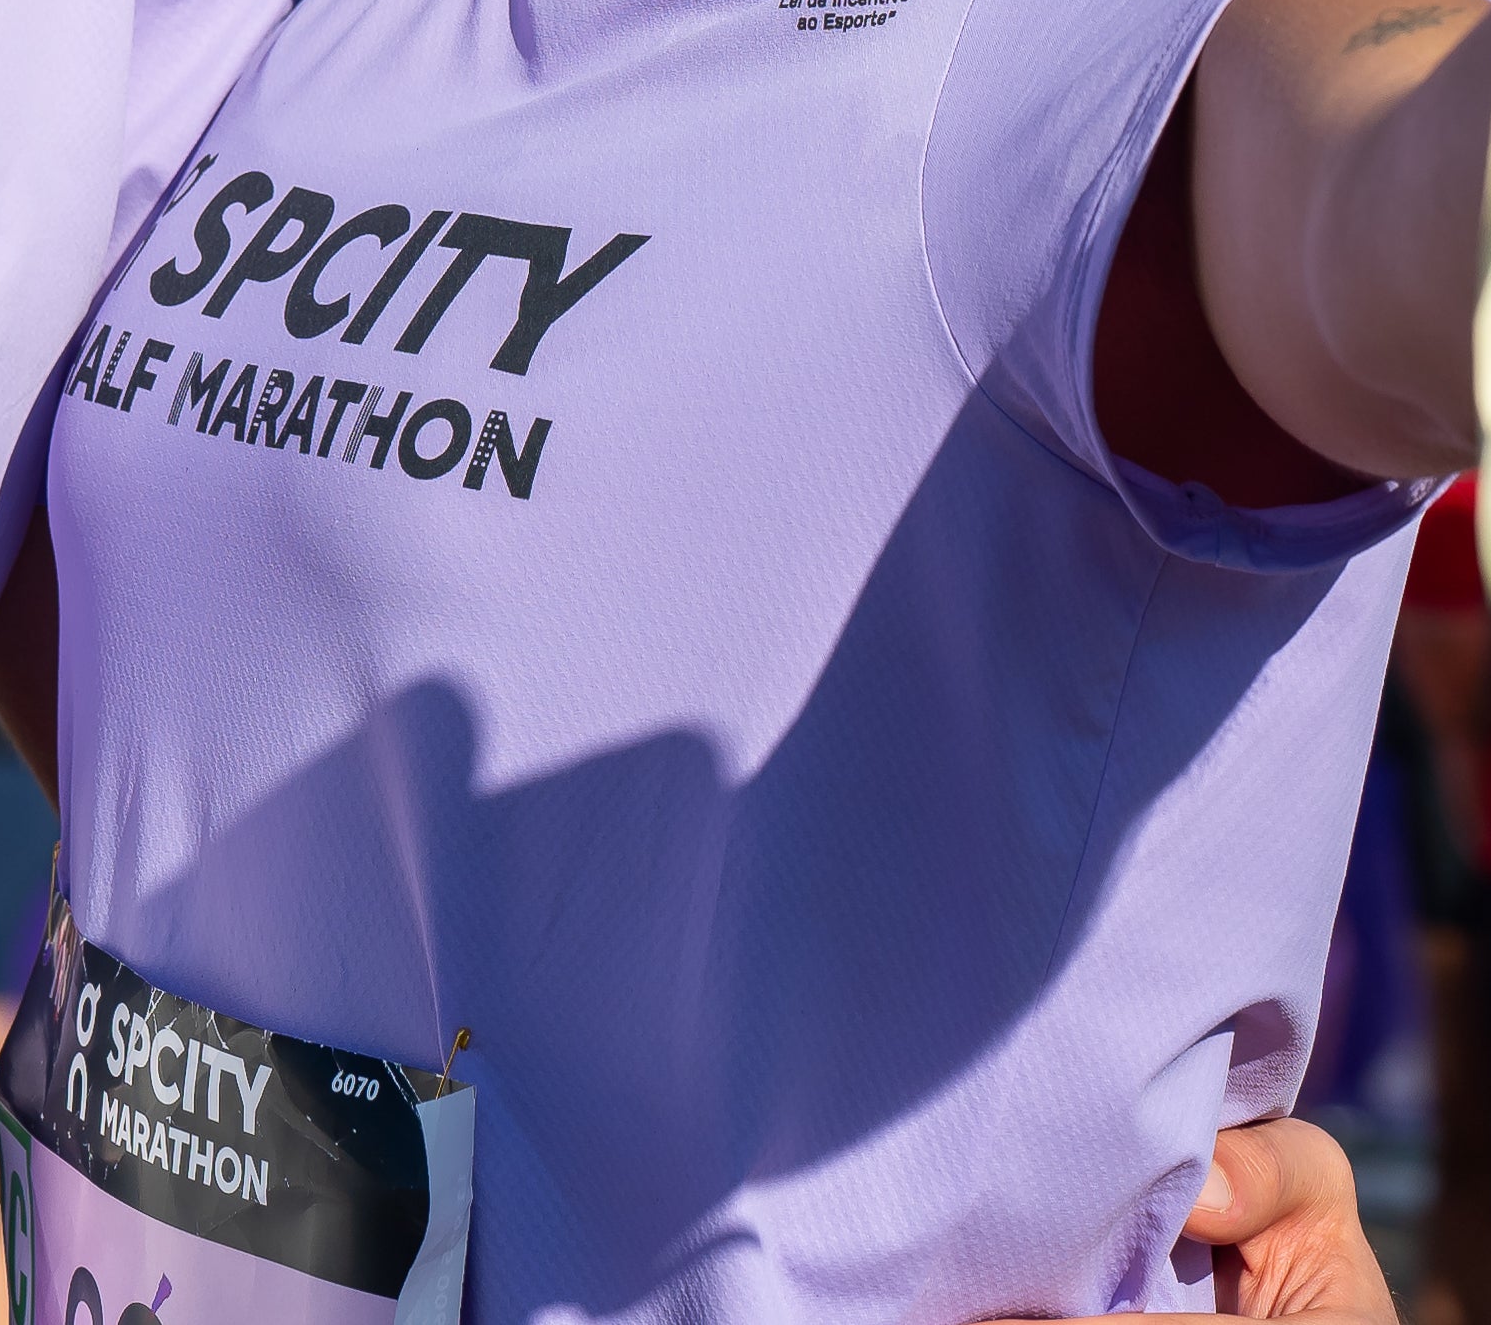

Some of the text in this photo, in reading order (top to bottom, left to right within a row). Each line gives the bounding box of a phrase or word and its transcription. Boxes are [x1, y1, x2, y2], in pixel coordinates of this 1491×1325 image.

[797, 15, 817, 31] ao
[149, 169, 653, 377] SPCITY
[167, 349, 554, 502] MARATHON
[106, 1002, 274, 1137] SPCITY
[331, 1068, 381, 1102] 6070
[99, 1089, 270, 1208] MARATHON
